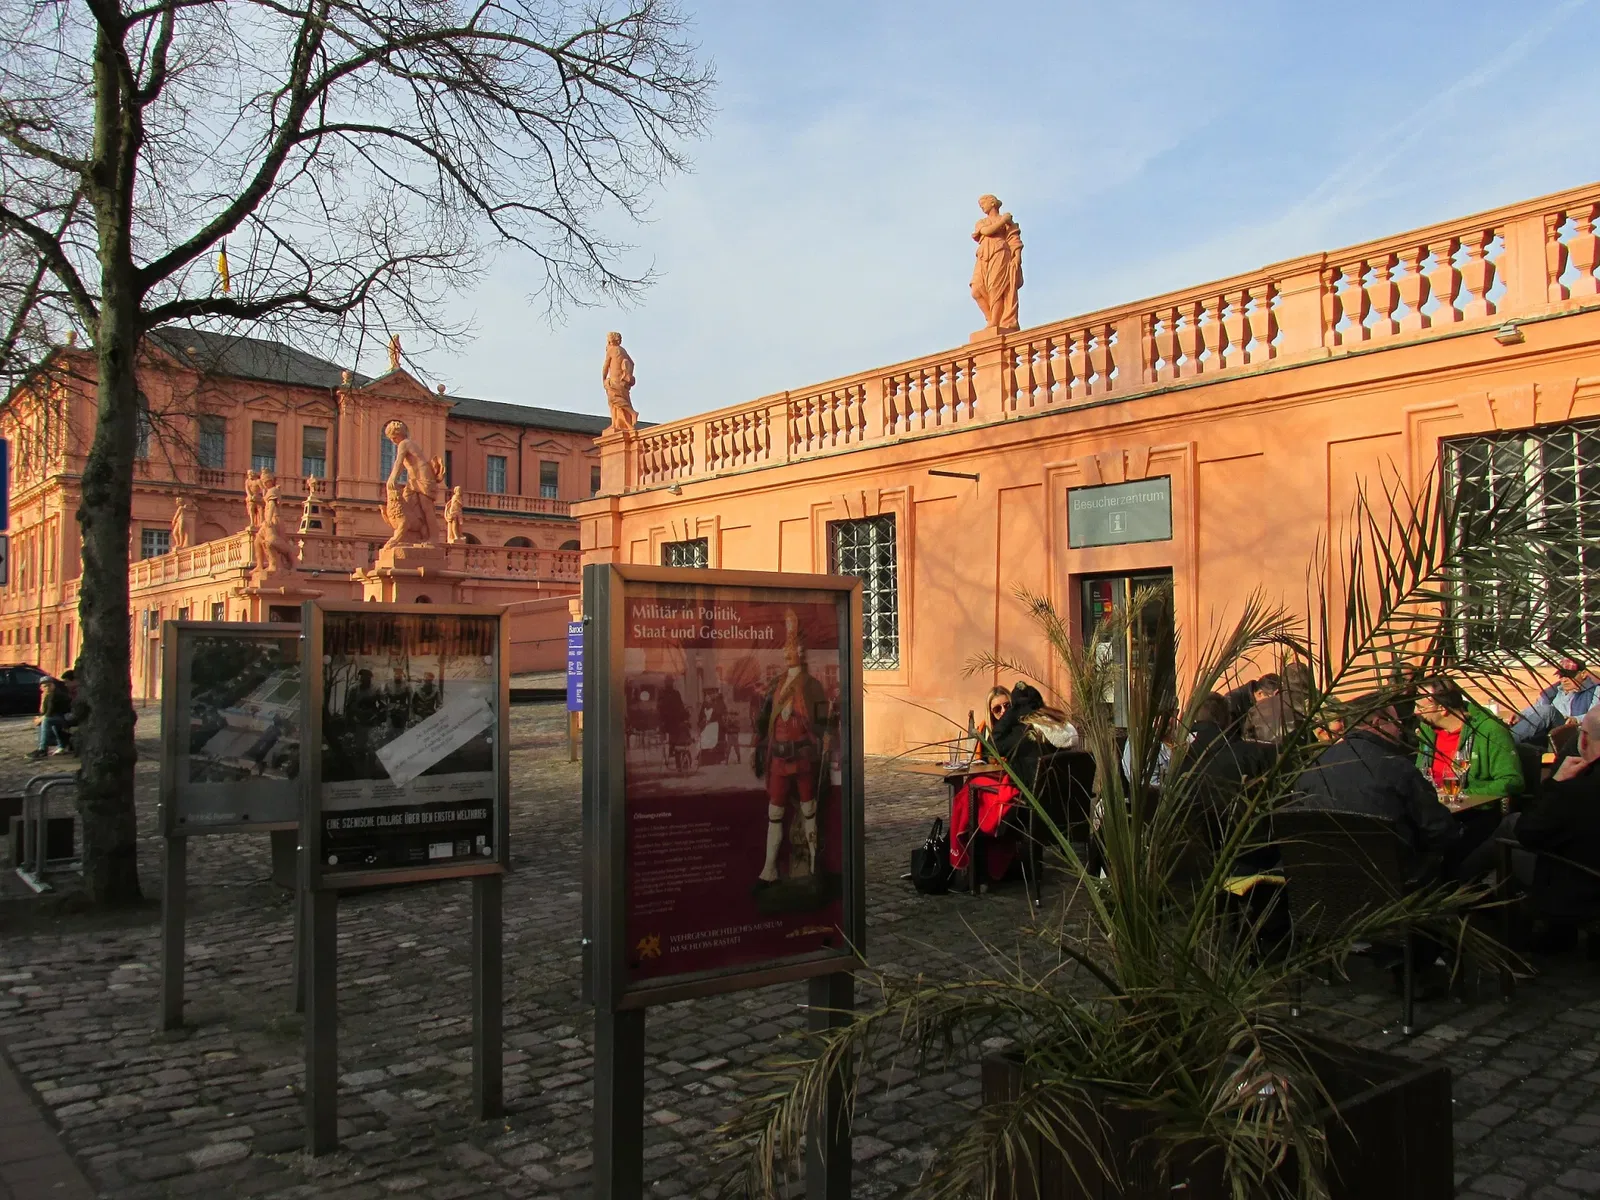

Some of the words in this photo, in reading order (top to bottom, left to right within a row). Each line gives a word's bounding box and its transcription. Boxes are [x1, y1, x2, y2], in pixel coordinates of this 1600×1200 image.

[1073, 490, 1164, 510] Besucherzentrum
[632, 605, 677, 620] Militär
[681, 606, 694, 620] in
[698, 606, 742, 623] Politik,
[633, 624, 667, 639] Staat
[670, 625, 695, 640] und
[699, 625, 774, 640] Gesellschaft
[326, 818, 341, 830] EINE
[342, 816, 375, 829] SZENISCHE
[376, 814, 403, 827] COLLAGE
[404, 811, 420, 825] ÜBER
[421, 812, 433, 824] DEN
[434, 810, 455, 823] ERSTEN
[456, 808, 487, 821] WELTKRIEG
[669, 925, 752, 943] WEHRGESCHICHTLICHES
[753, 919, 783, 932] MUSEUM
[669, 944, 681, 954] IM
[681, 941, 712, 953] SCHLOSS
[713, 936, 741, 949] RASTATT
